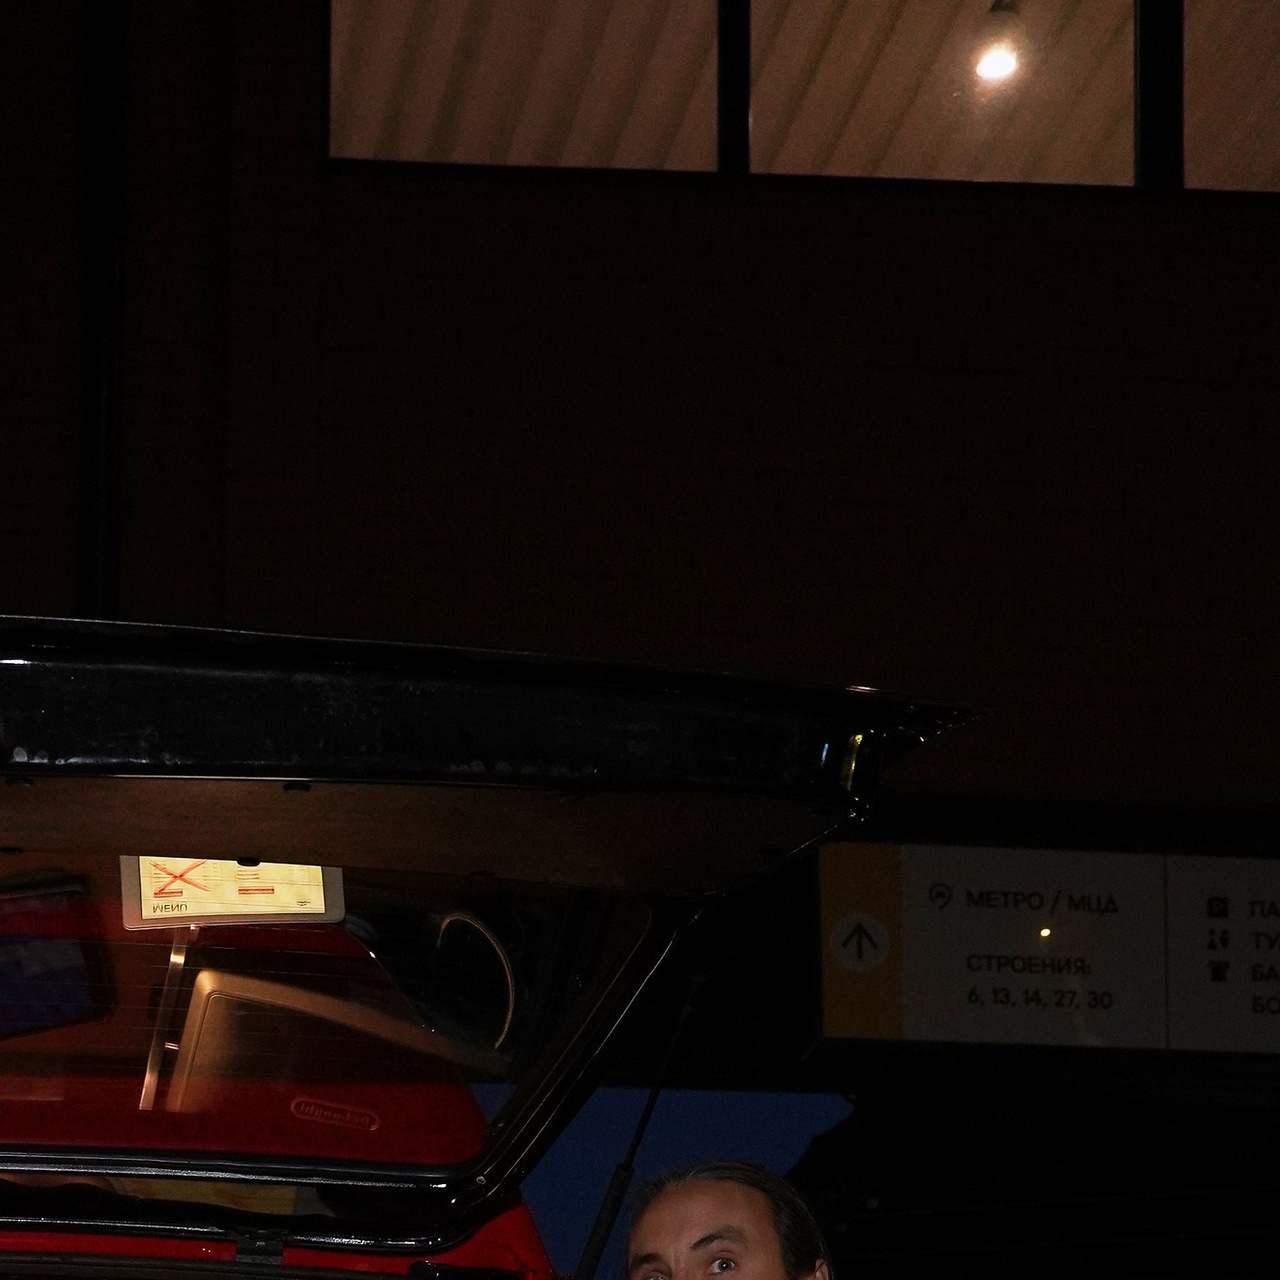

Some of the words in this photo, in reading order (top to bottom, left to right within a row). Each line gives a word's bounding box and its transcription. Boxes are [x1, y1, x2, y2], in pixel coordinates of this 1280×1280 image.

[966, 890, 1044, 910] МЕТРО
[1068, 894, 1119, 915] МЦД
[1250, 900, 1280, 917] ПА
[1252, 932, 1280, 949] ТУ
[967, 954, 1091, 976] СТРОЕНИЯ:
[1252, 964, 1280, 982] БА
[1088, 991, 1113, 1009] 30
[1252, 996, 1280, 1014] БО
